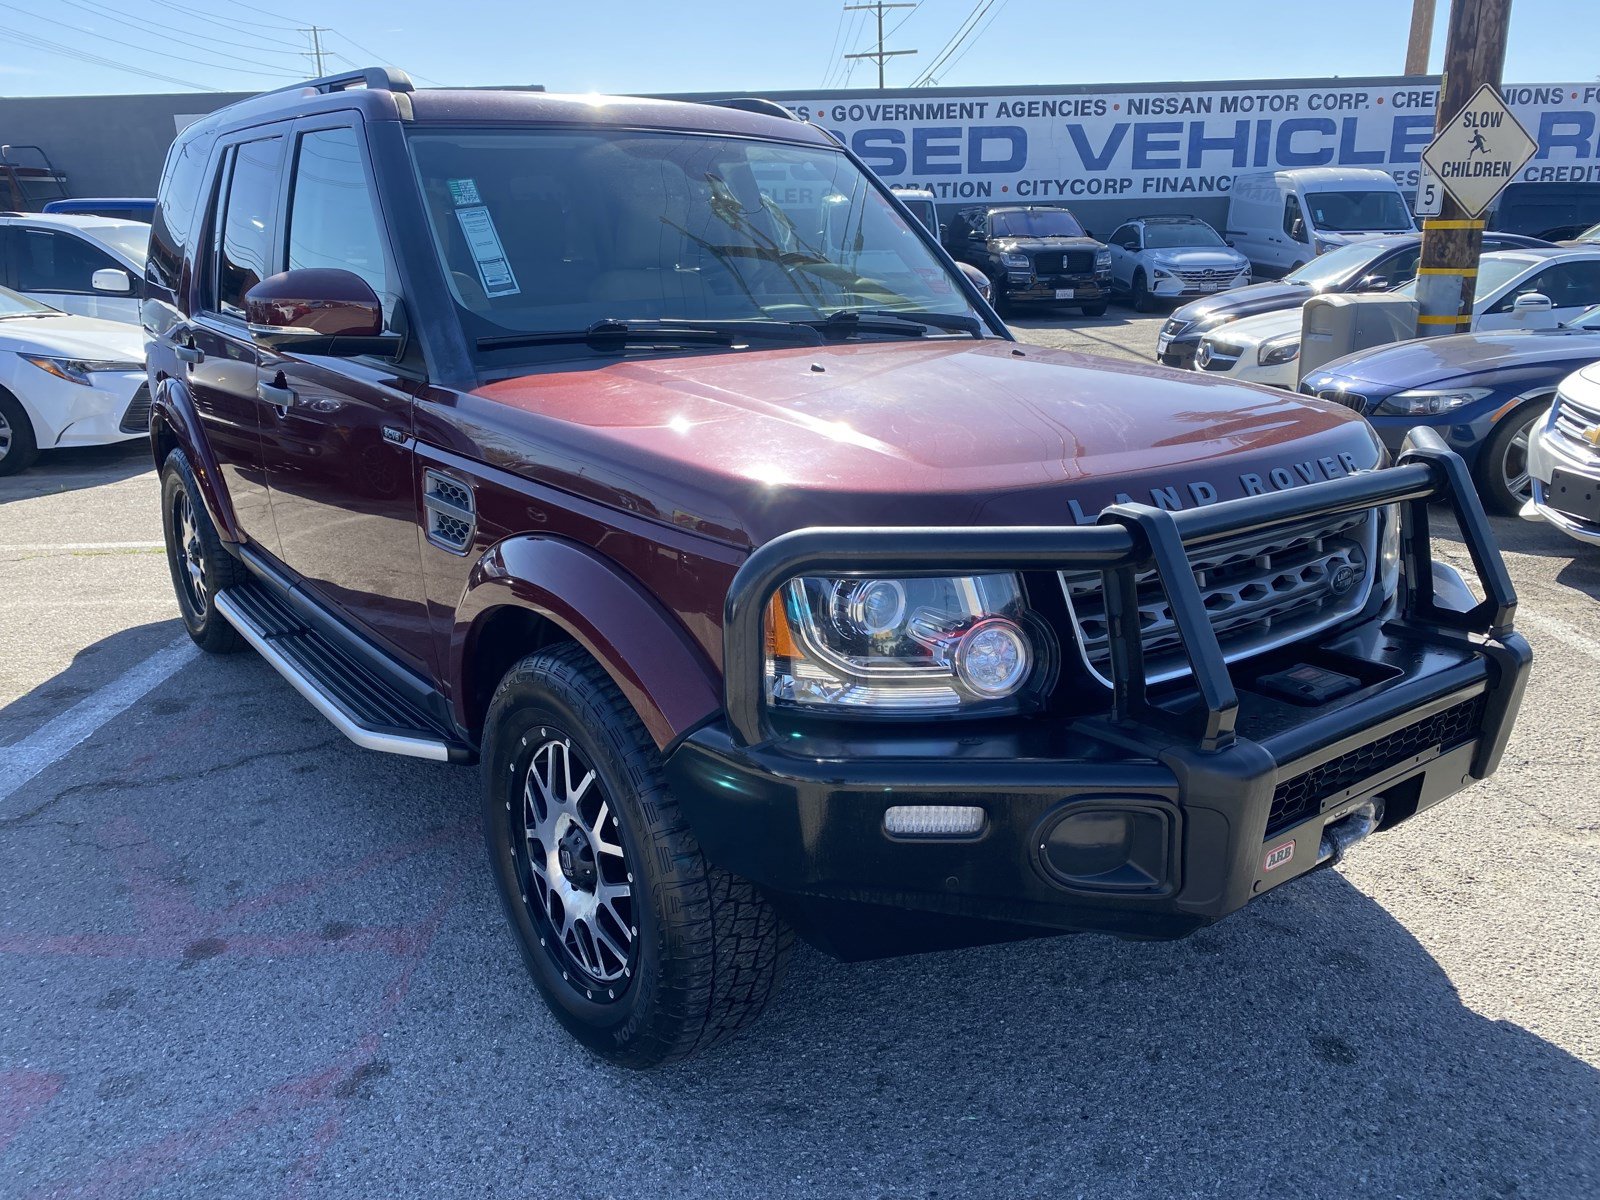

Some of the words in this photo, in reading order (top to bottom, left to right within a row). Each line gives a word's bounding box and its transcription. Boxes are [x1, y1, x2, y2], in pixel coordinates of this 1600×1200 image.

[831, 102, 989, 122] GOVERNMENT
[997, 99, 1107, 119] AGENCIES
[1126, 97, 1212, 115] NISSAN
[1219, 94, 1300, 113] MOTOR
[1307, 92, 1370, 111] CORP.
[1500, 88, 1564, 106] NIONS
[1463, 111, 1505, 128] SLOW
[828, 125, 1028, 177] SED
[1066, 114, 1437, 171] VEHICLE
[1441, 161, 1512, 178] CHILDREN
[1016, 178, 1133, 197] CITYCORP
[1424, 184, 1436, 206] 5
[1239, 451, 1358, 497] ROVER
[1267, 846, 1292, 868] ARB
